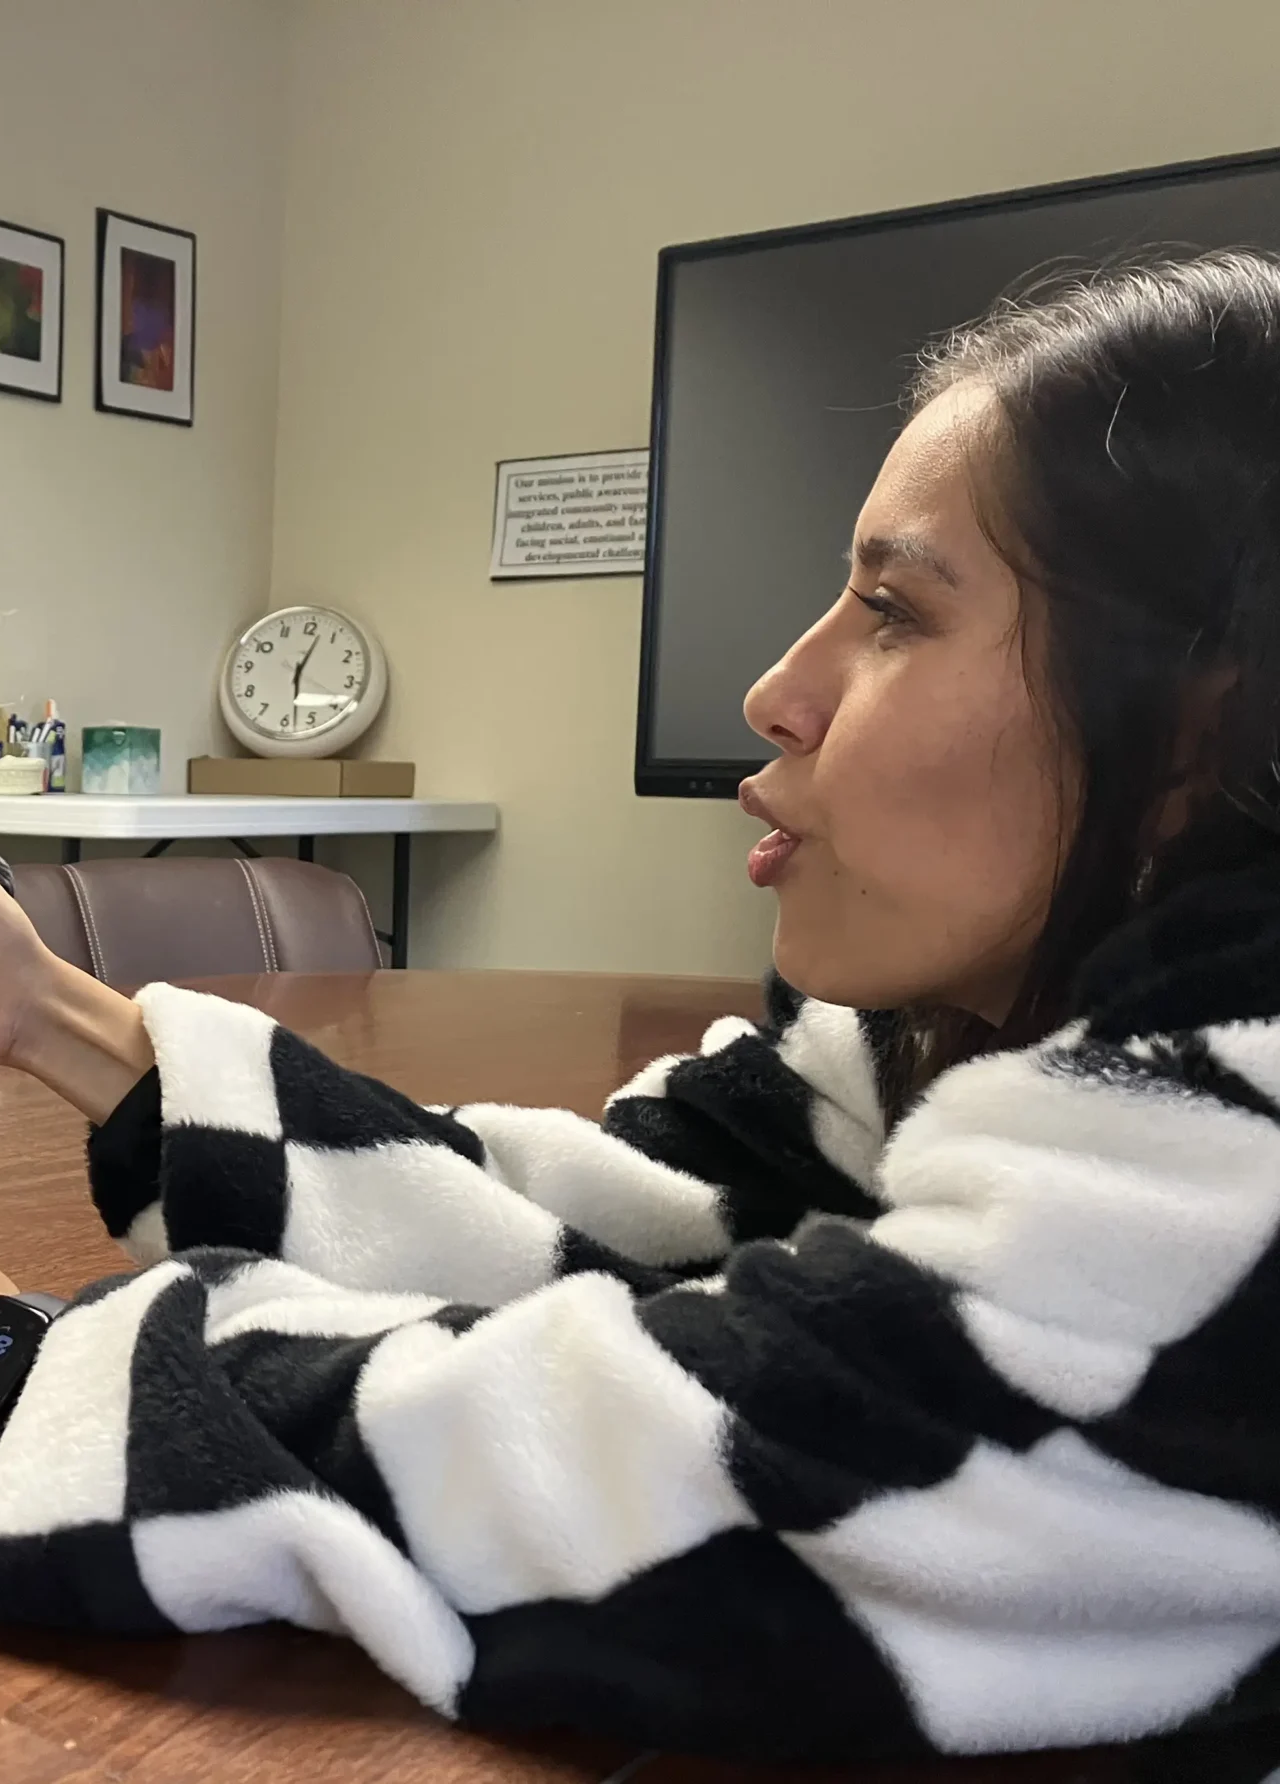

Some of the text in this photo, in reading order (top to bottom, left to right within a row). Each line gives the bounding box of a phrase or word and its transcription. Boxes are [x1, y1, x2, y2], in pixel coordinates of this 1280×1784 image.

[589, 473, 599, 483] to
[602, 469, 642, 485] provide
[606, 516, 626, 527] and
[279, 625, 291, 638] 11
[303, 622, 318, 636] 12
[330, 632, 337, 644] 1
[255, 641, 274, 653] 10
[342, 650, 353, 663] 2
[244, 661, 254, 673] 9
[344, 675, 355, 688] 3
[244, 684, 255, 698] 8
[258, 702, 269, 716] 7
[280, 714, 290, 727] 6
[305, 711, 317, 724] 5
